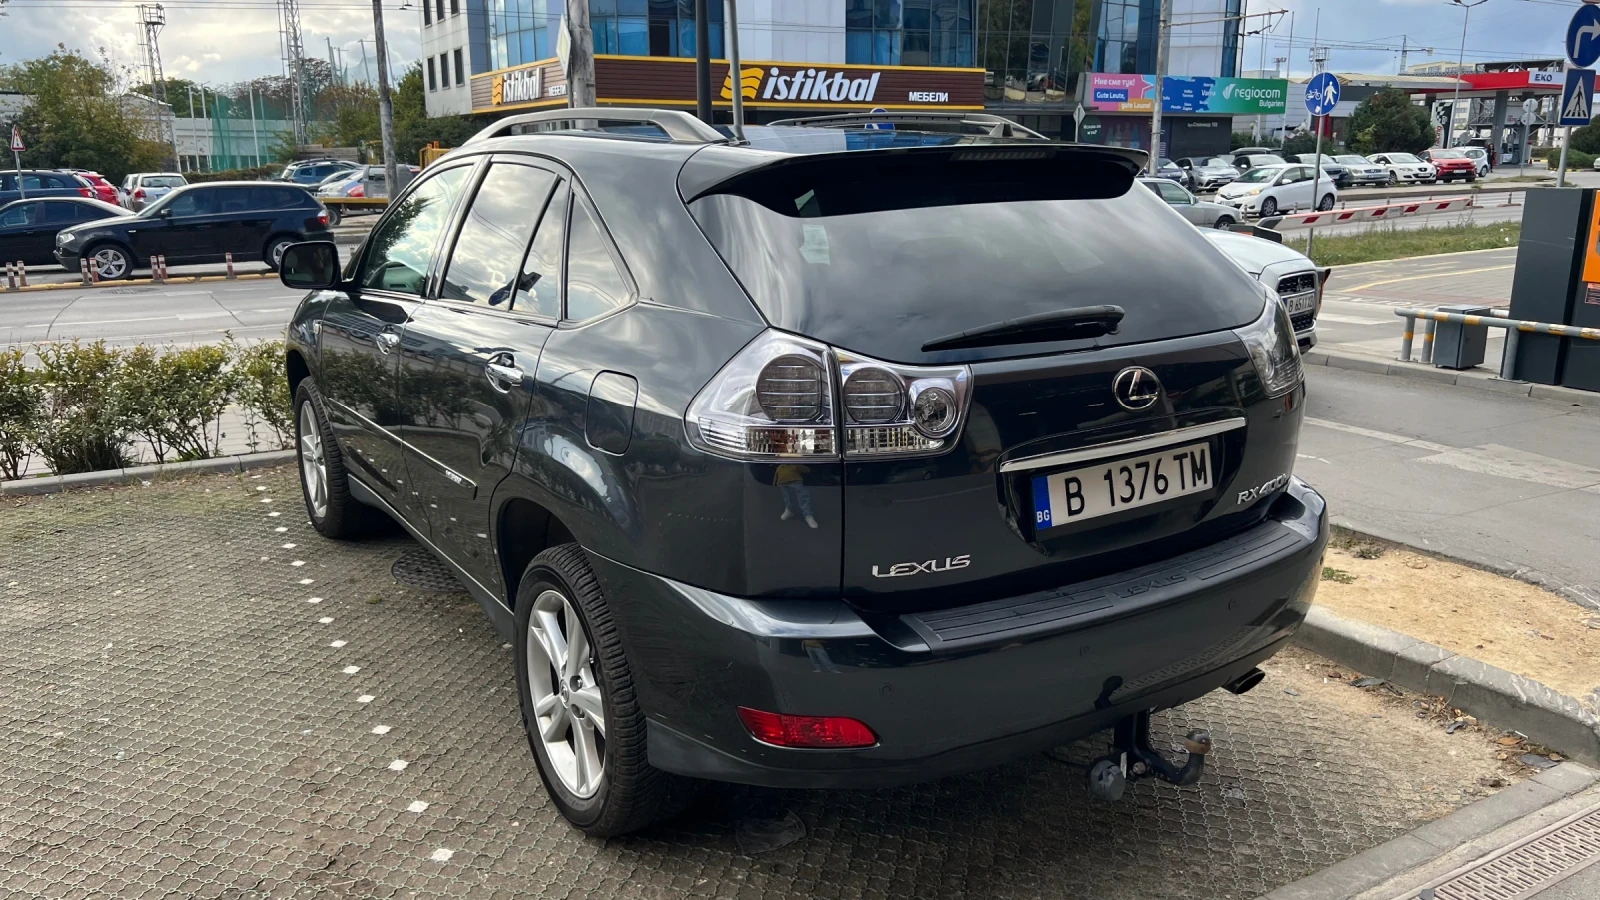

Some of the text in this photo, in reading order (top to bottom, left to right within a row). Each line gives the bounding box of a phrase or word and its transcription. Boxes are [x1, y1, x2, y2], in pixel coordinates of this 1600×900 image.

[504, 66, 542, 102] istikbal
[763, 67, 881, 101] istikbal
[1094, 77, 1107, 85] Ние
[1122, 79, 1135, 88] тук!
[1534, 73, 1553, 82] EKO
[909, 92, 948, 102] МЕБЕЛИ
[1096, 91, 1126, 100] Gute Leute,
[1201, 89, 1216, 97] Varna
[1234, 86, 1281, 101] regiocom
[1258, 99, 1284, 109] Bulgarien
[1064, 448, 1208, 517] B 1376 TM
[1036, 510, 1050, 523] BG
[872, 554, 971, 578] LEXUS
[1114, 573, 1188, 599] LEXUS
